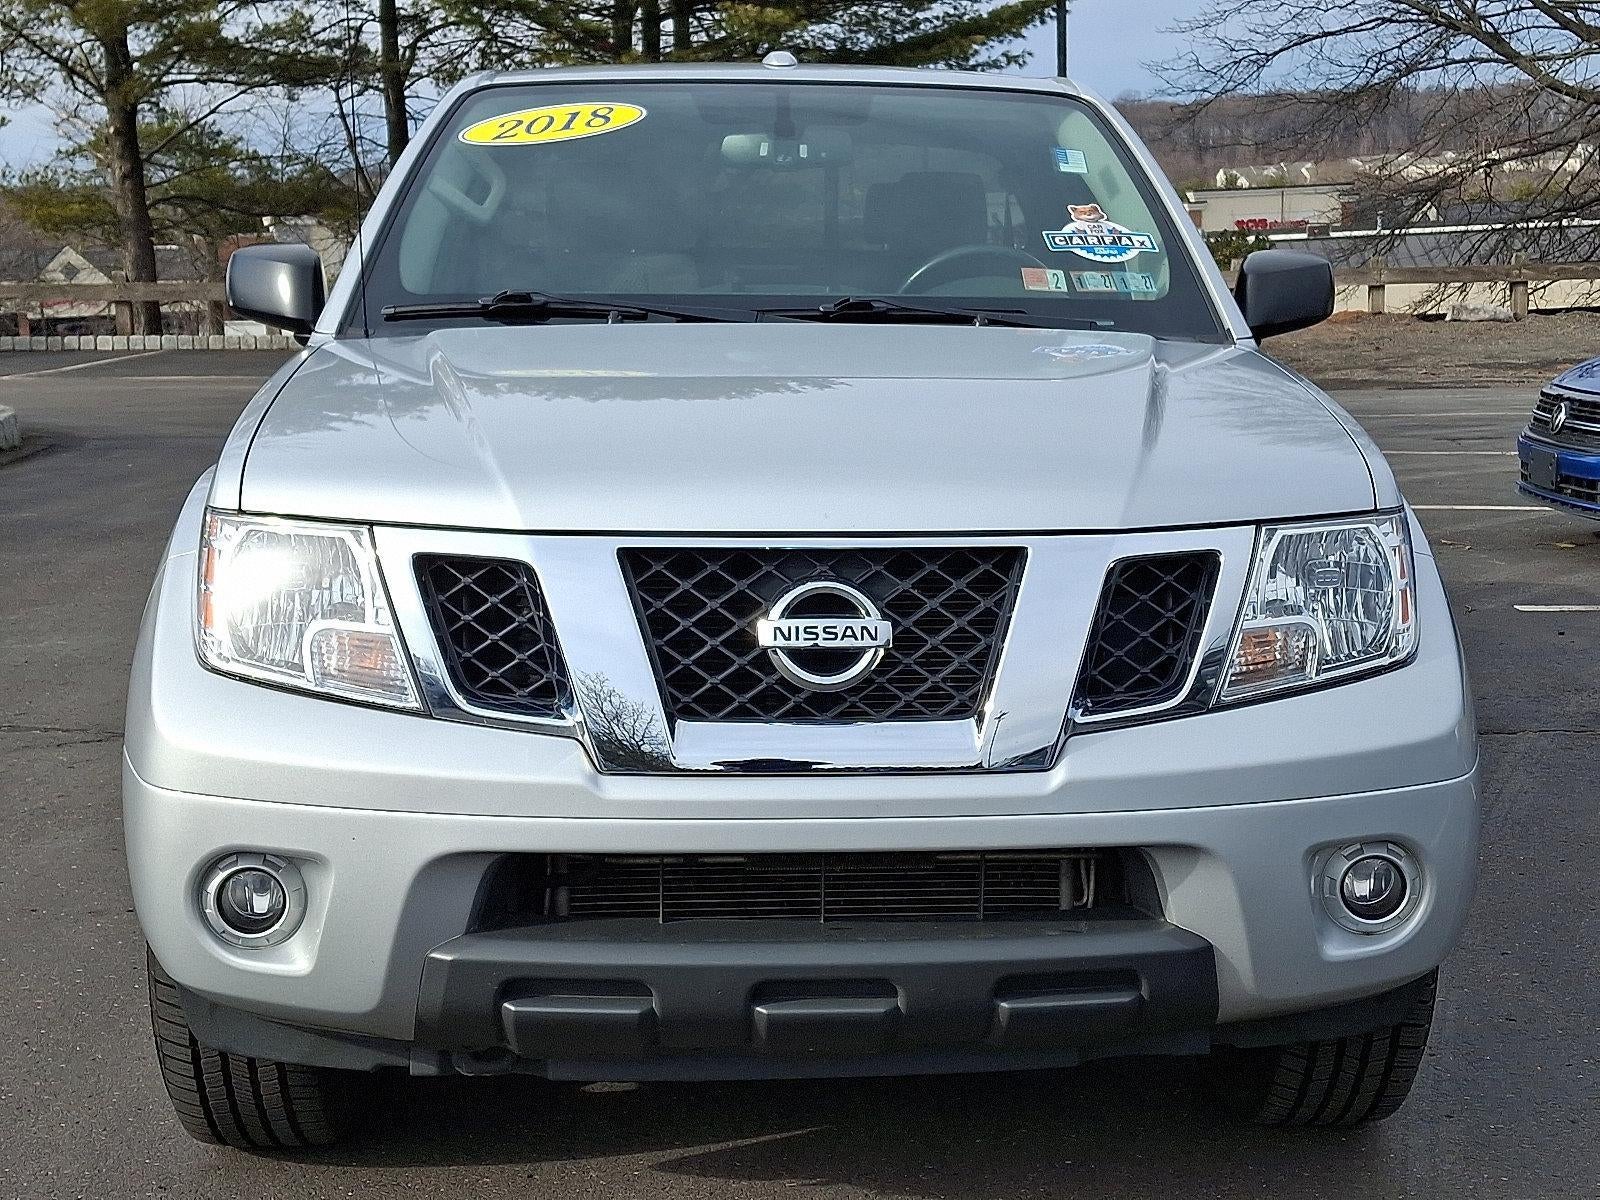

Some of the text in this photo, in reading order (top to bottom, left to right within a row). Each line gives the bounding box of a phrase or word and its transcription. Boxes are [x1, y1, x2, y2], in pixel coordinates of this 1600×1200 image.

[491, 106, 614, 140] 2018
[1053, 235, 1149, 248] CARFAX
[1052, 272, 1062, 290] 2
[773, 625, 878, 642] NISSAN
